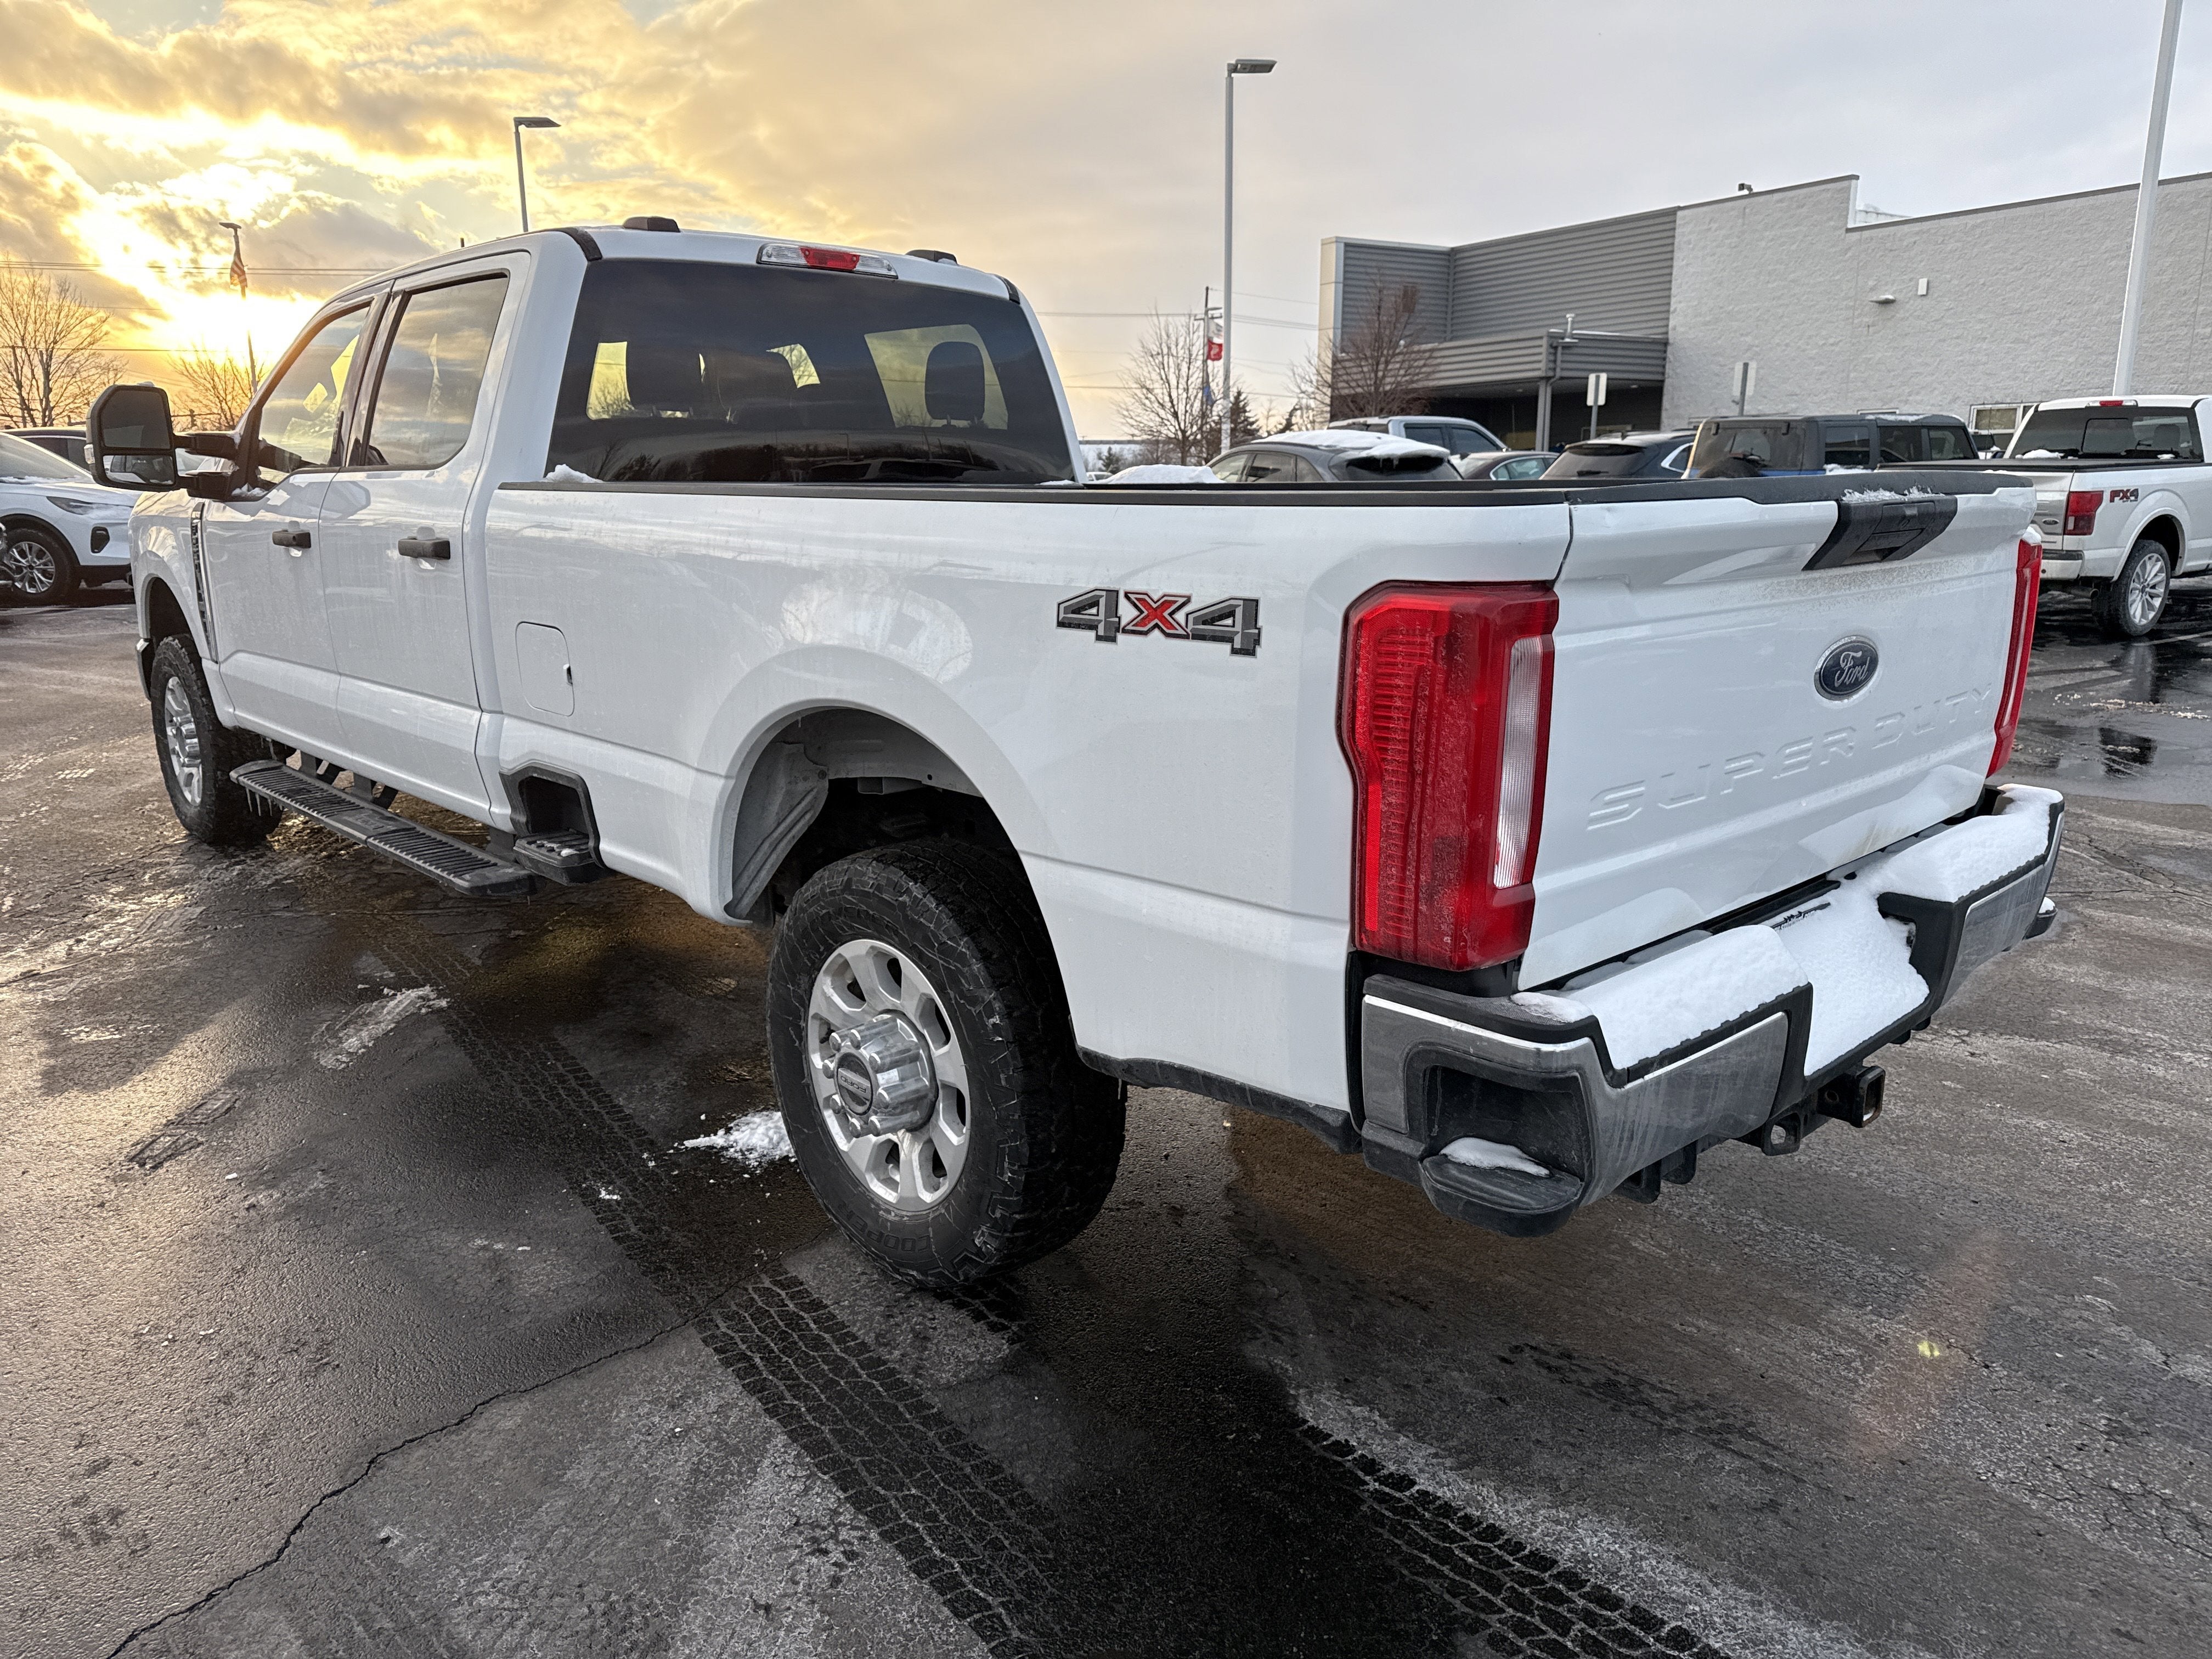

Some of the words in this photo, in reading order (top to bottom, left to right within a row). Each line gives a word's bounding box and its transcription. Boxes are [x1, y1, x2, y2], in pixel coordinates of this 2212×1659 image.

[2109, 488, 2139, 503] FX4
[1834, 650, 1870, 687] Ford
[1586, 726, 1857, 831] SUPER
[1872, 682, 1991, 749] DUTY
[840, 1075, 867, 1093] FORD
